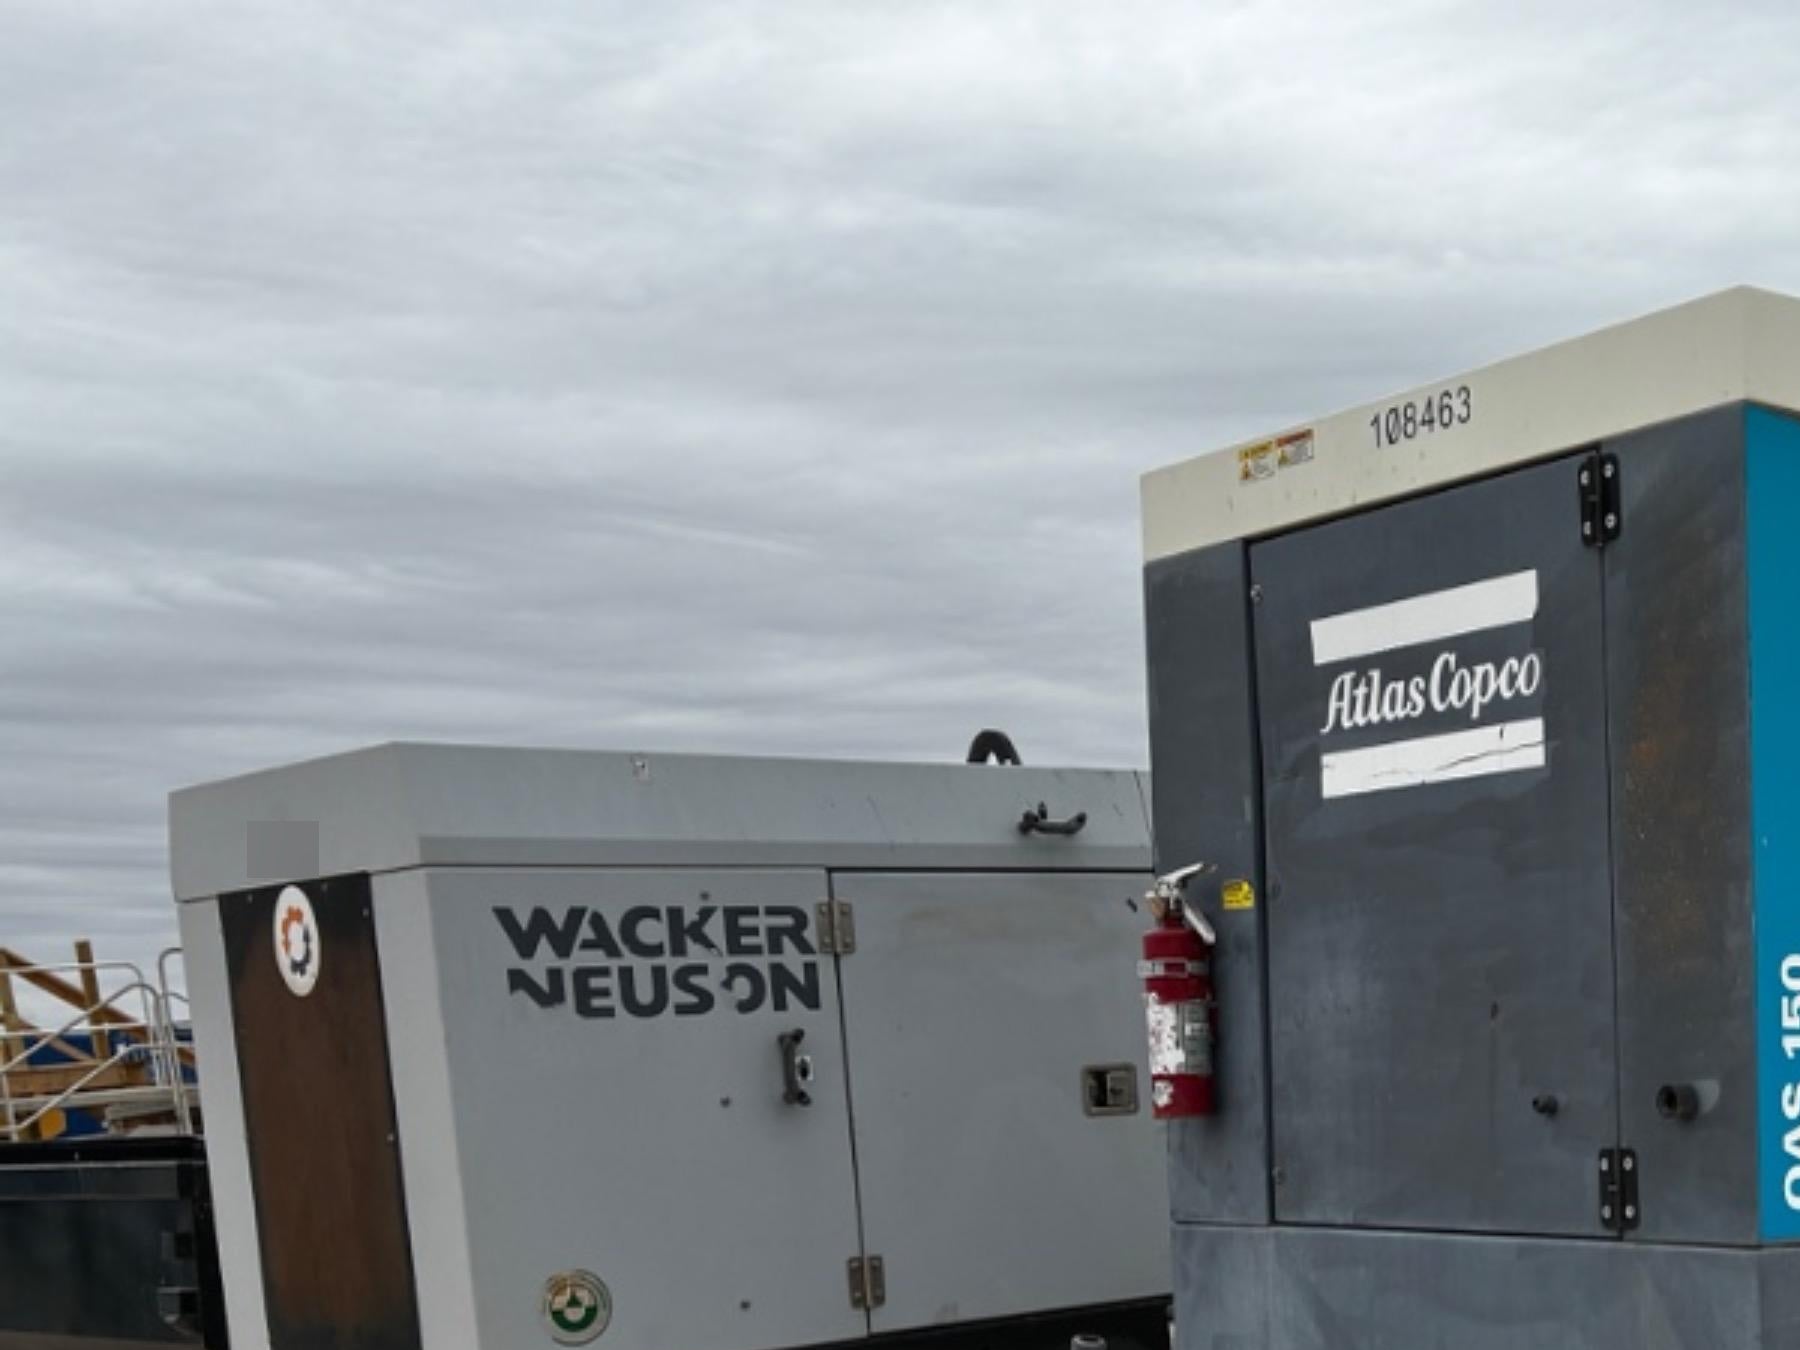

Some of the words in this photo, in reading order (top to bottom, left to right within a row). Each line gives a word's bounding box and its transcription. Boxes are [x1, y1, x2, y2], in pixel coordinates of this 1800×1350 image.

[1370, 386, 1471, 449] 108463
[492, 905, 817, 960] WACKER
[506, 962, 821, 1018] NEUSON
